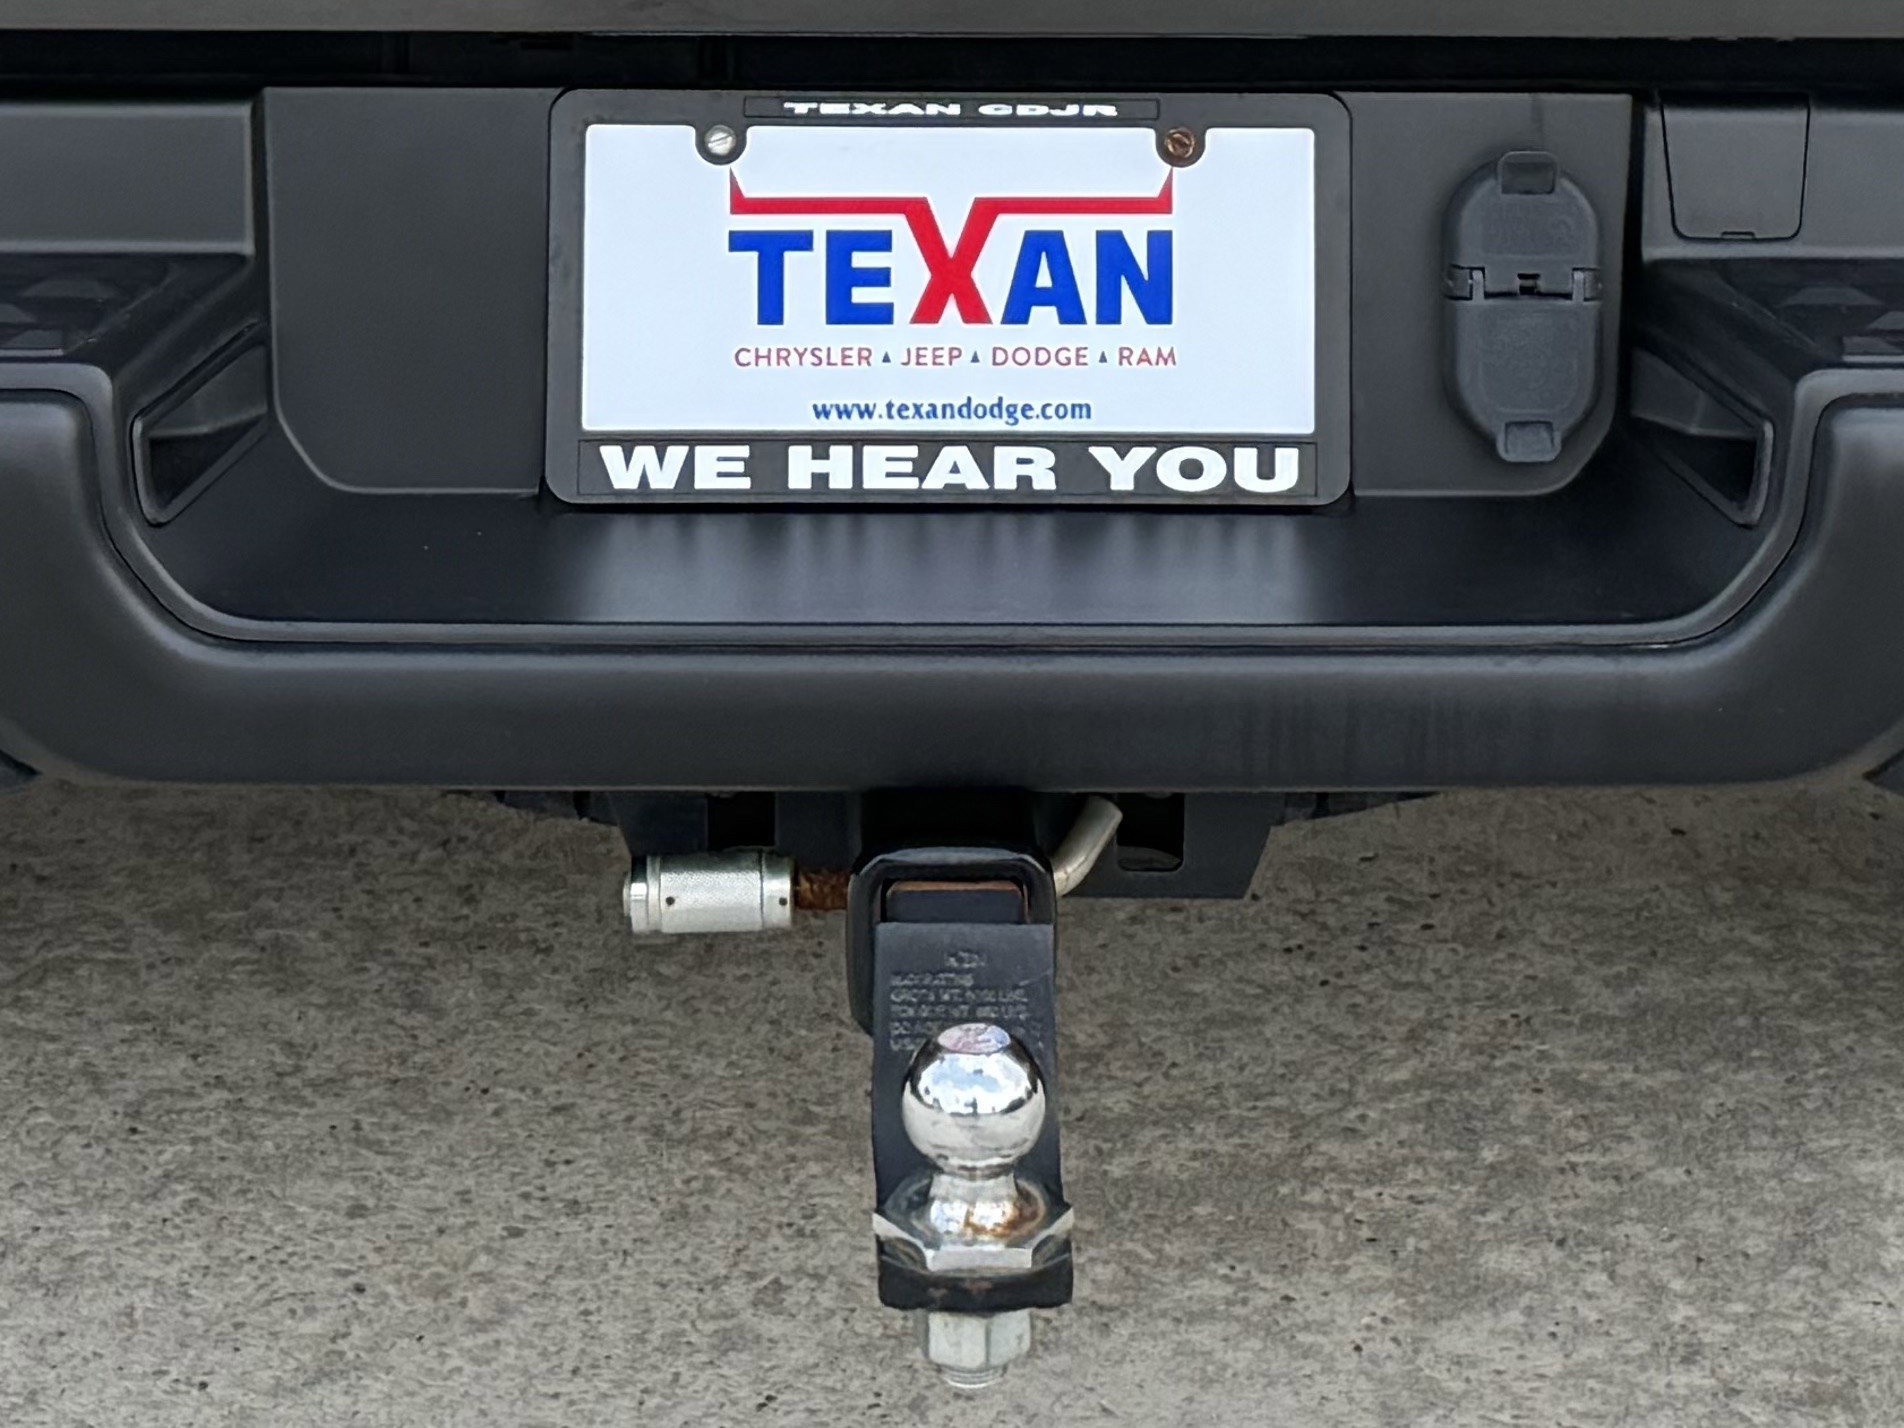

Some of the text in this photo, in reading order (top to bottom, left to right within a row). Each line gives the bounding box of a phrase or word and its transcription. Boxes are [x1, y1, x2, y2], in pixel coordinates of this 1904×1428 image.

[782, 100, 1119, 118] TEXAN CDJR
[728, 194, 1174, 326] TEXAN
[734, 346, 1178, 368] CHRYSLER JEEP DODGE RAM
[811, 396, 1093, 425] www.texandodge.com
[598, 444, 1299, 494] WE HEAR YOU
